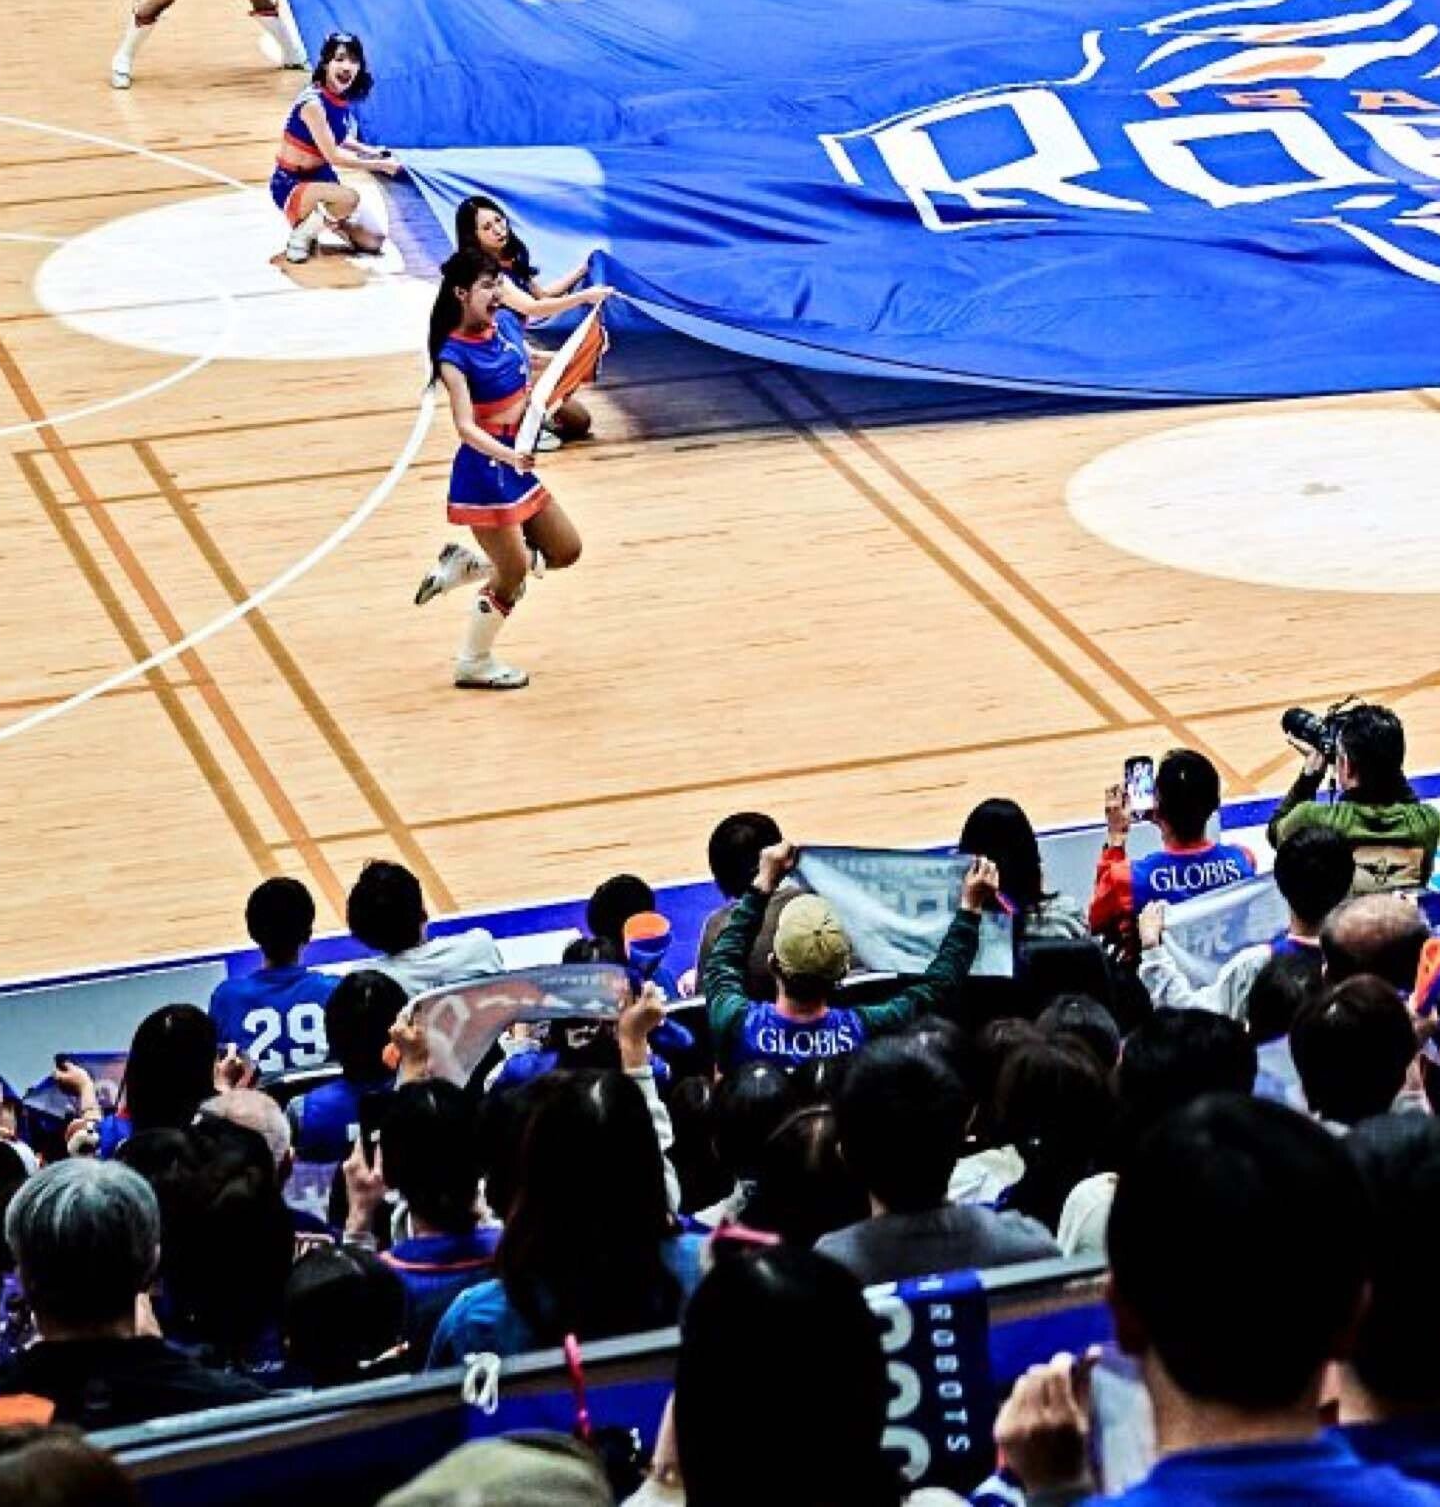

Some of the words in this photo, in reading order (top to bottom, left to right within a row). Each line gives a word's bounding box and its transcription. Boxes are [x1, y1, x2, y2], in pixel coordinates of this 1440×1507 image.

[1149, 858, 1242, 894] GLOBIS
[242, 1004, 329, 1072] 29
[756, 1023, 855, 1058] GLOBIS
[927, 1302, 972, 1452] ROBOTS
